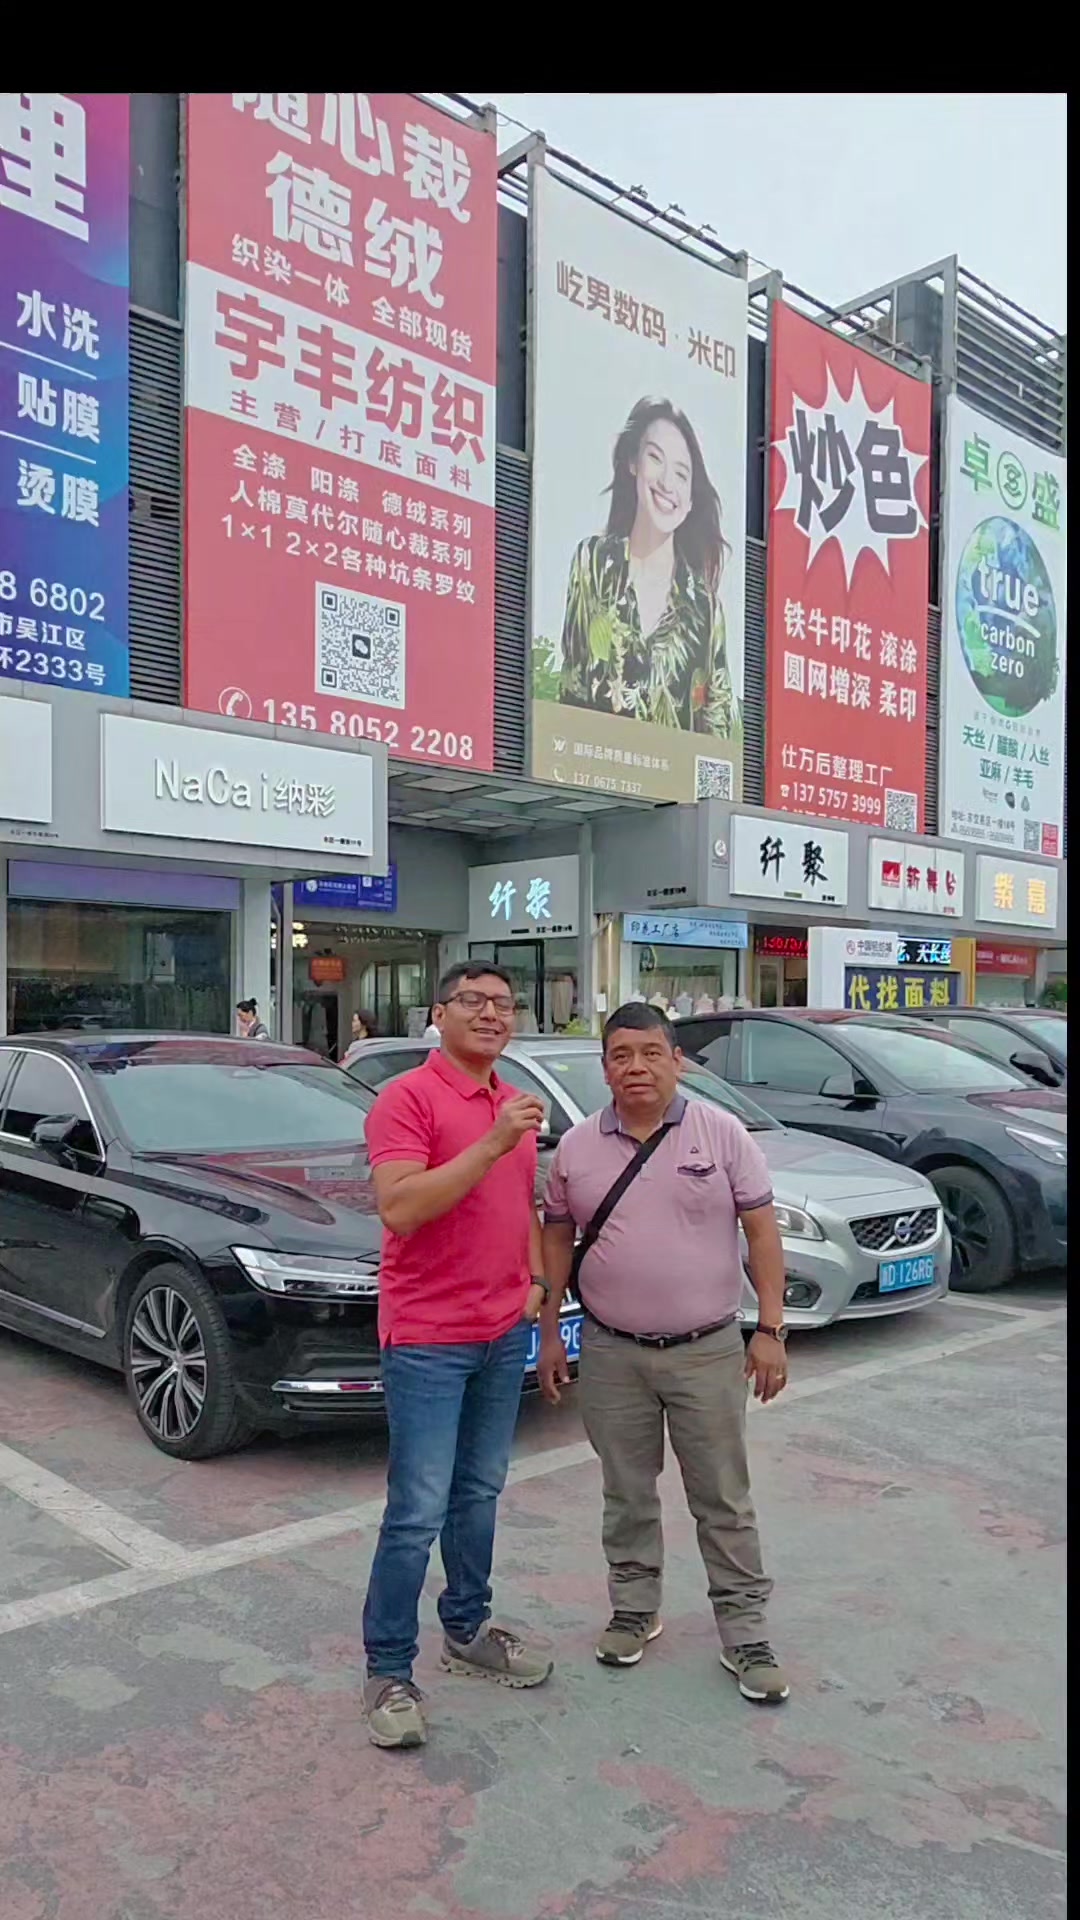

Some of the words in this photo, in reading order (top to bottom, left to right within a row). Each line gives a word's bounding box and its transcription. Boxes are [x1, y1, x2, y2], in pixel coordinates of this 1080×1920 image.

[265, 149, 444, 308] 德绒
[16, 289, 100, 360] 水洗
[232, 233, 350, 308] 织染一体
[372, 295, 473, 363] 全部现货
[17, 371, 100, 444] 贴膜
[215, 289, 486, 465] 宇丰纺织
[229, 389, 473, 491] 主营/打底面料
[788, 409, 917, 534] 炒色
[17, 458, 100, 527] 烫膜
[229, 479, 472, 572] 人棉莫代尔随心裁系列
[232, 443, 287, 481] 全涤
[311, 466, 360, 504] 阳涤
[382, 490, 472, 540] 德绒系列
[30, 577, 106, 621] 6802
[978, 554, 1040, 618] true
[784, 598, 873, 661] 铁牛印花
[879, 630, 918, 674] 滚涂
[980, 621, 1036, 658] carbon
[991, 651, 1024, 678] zero
[784, 650, 872, 710] 圆网增深
[879, 680, 917, 722] 柔印
[263, 698, 318, 731] 135
[330, 710, 399, 748] 8052
[410, 726, 473, 761] 2208
[792, 781, 815, 803] 137
[817, 787, 849, 810] 5757
[851, 793, 882, 816] 3999
[848, 973, 951, 1010] 代找面料
